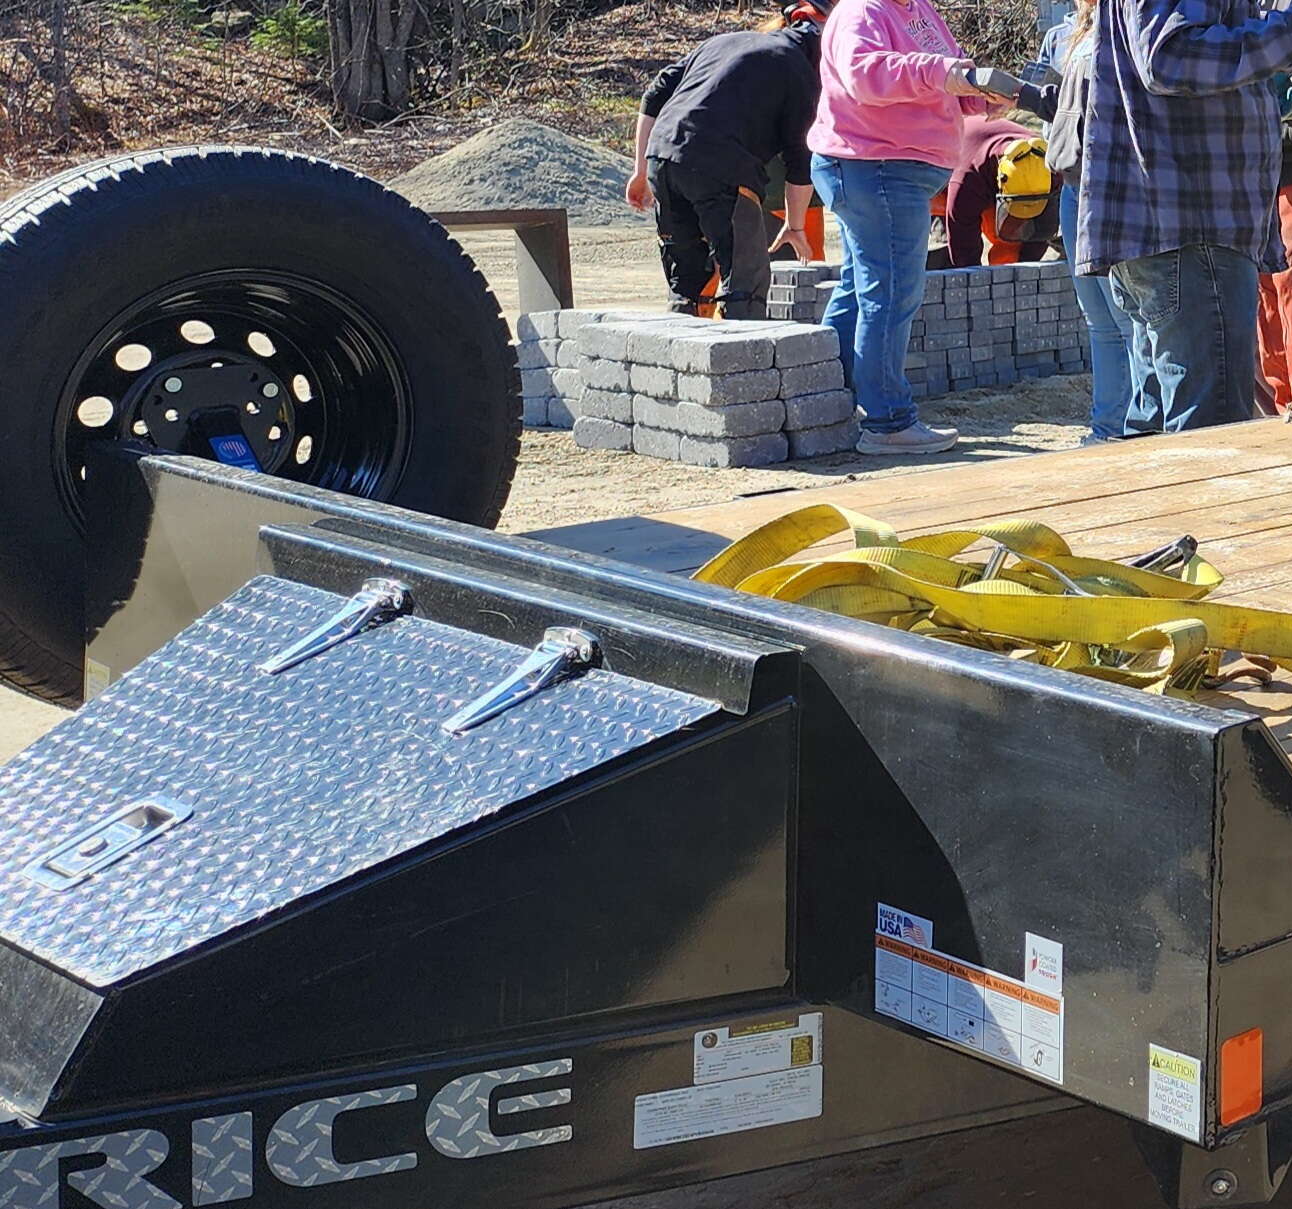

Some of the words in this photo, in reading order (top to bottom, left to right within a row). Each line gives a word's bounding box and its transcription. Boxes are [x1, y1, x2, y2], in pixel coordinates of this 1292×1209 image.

[879, 917, 902, 939] USA
[1160, 1058, 1195, 1079] CAUTION
[0, 1058, 573, 1209] RICE
